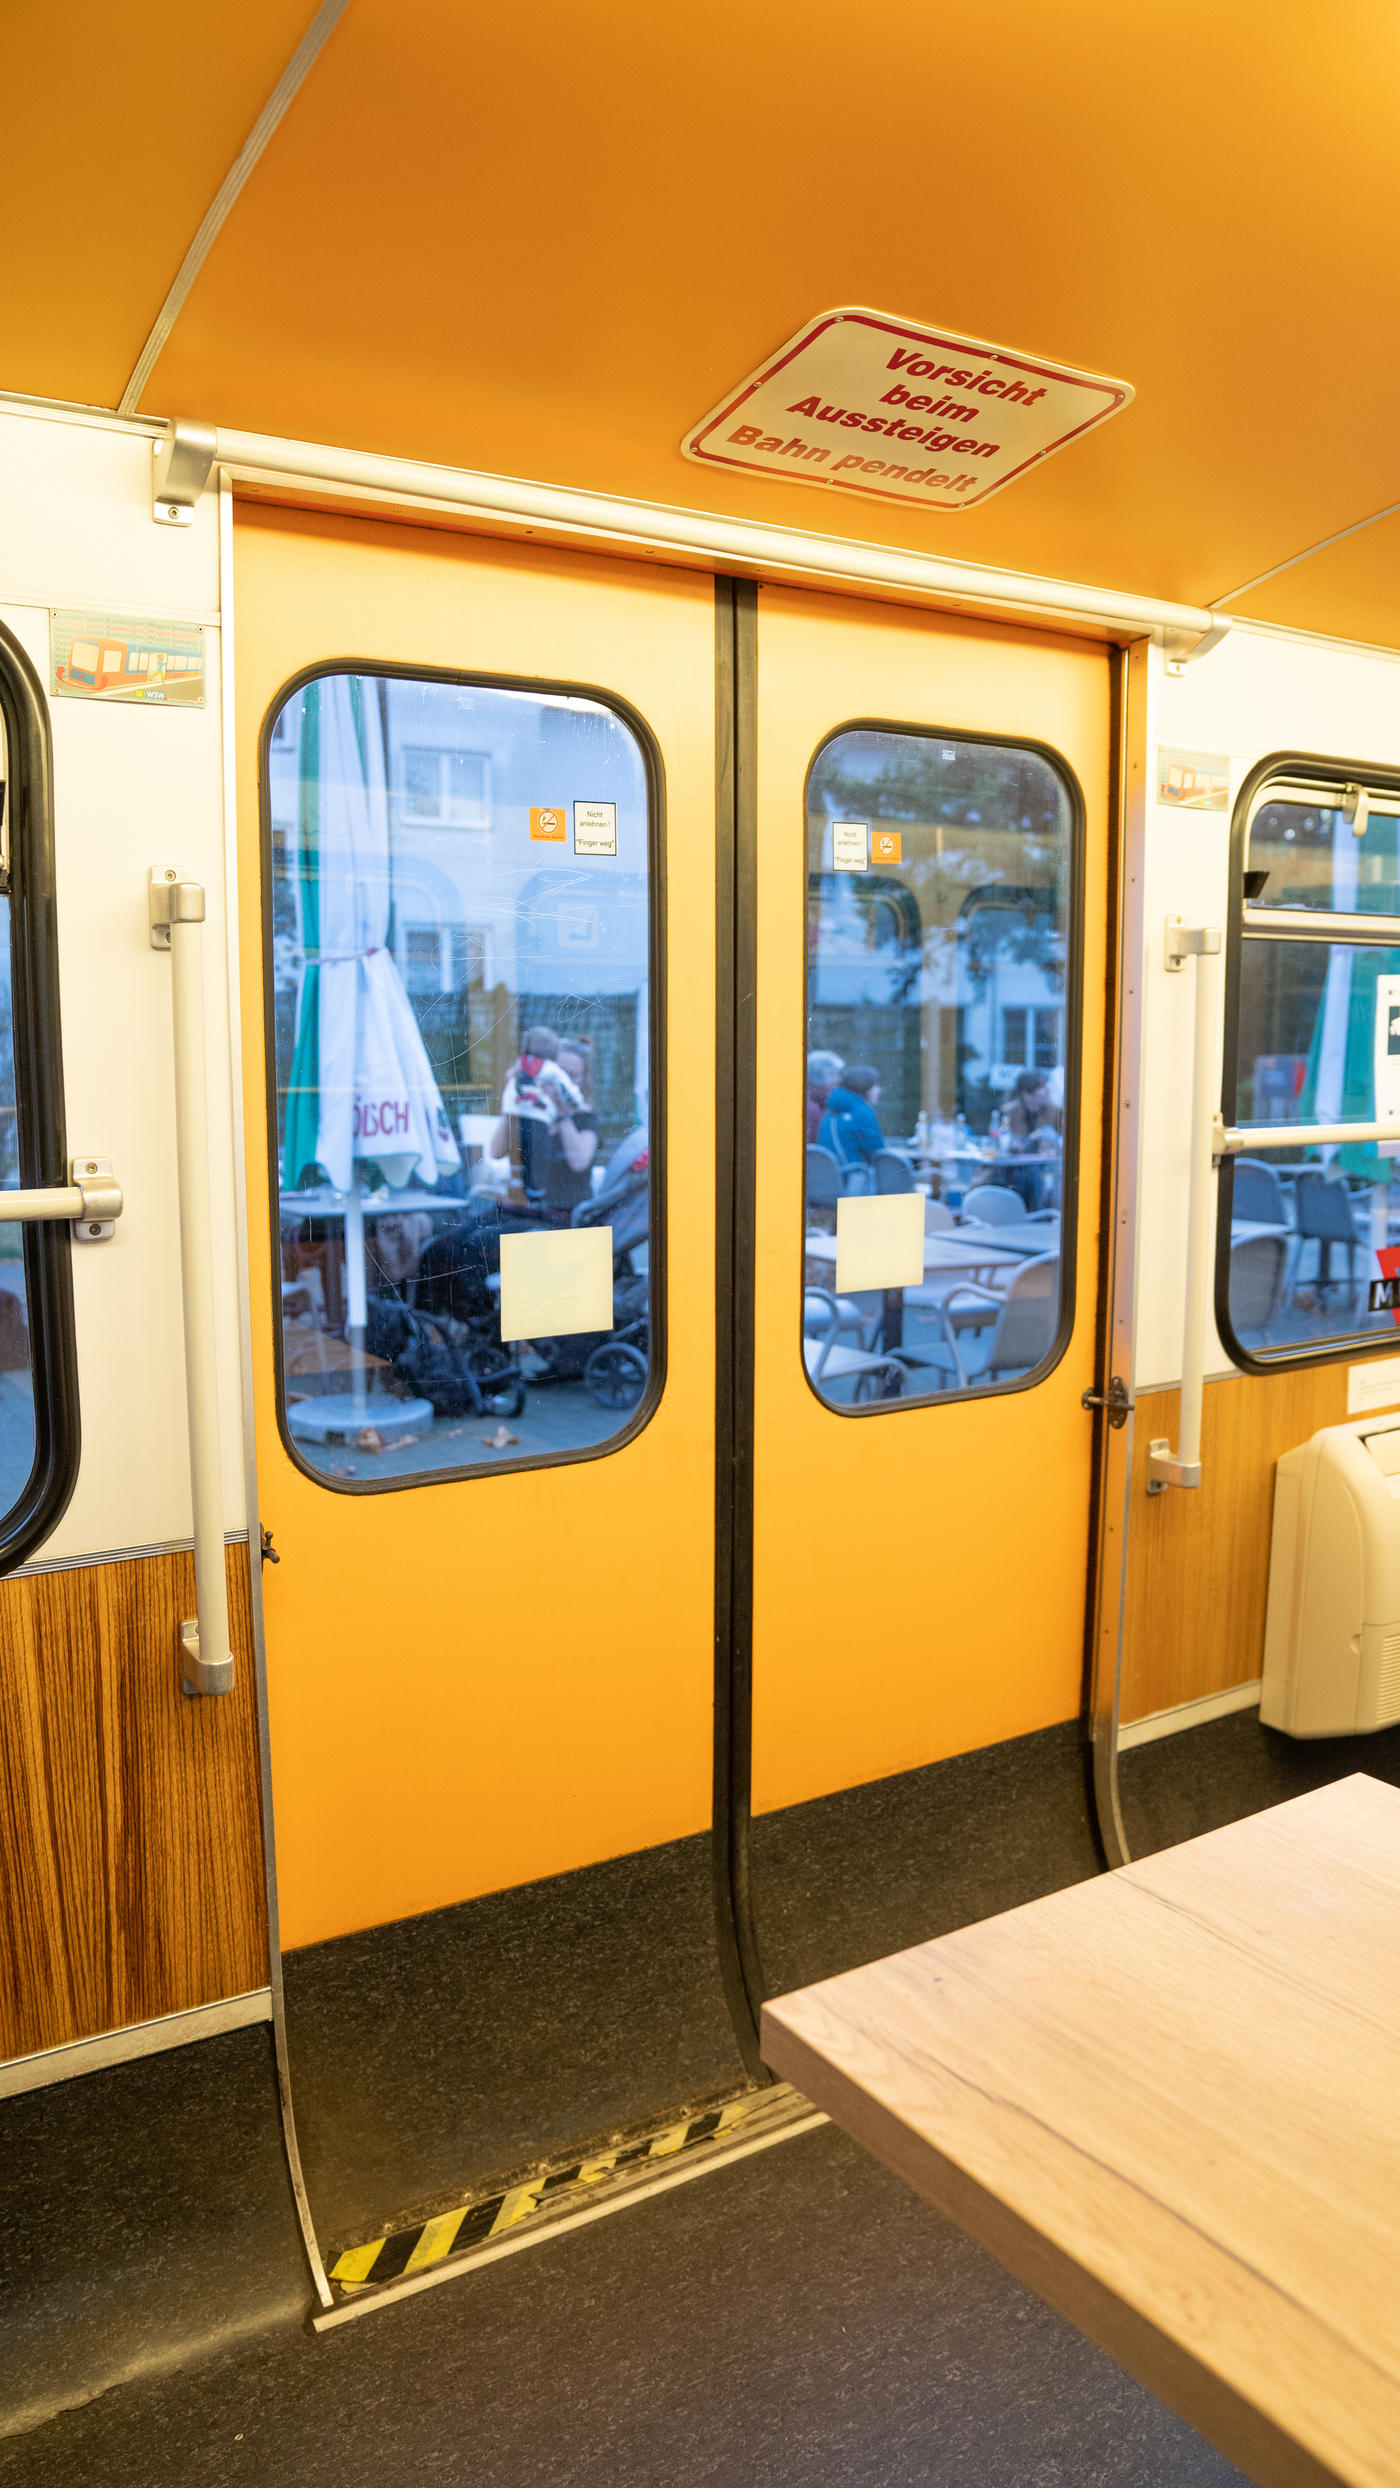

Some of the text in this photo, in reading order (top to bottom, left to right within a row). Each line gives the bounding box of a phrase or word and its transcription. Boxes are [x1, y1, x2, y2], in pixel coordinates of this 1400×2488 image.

[879, 384, 980, 423] beim
[884, 347, 1049, 406] Vorsicht
[785, 396, 1001, 459] Aussteigen
[726, 424, 980, 494] Bahn pendelt
